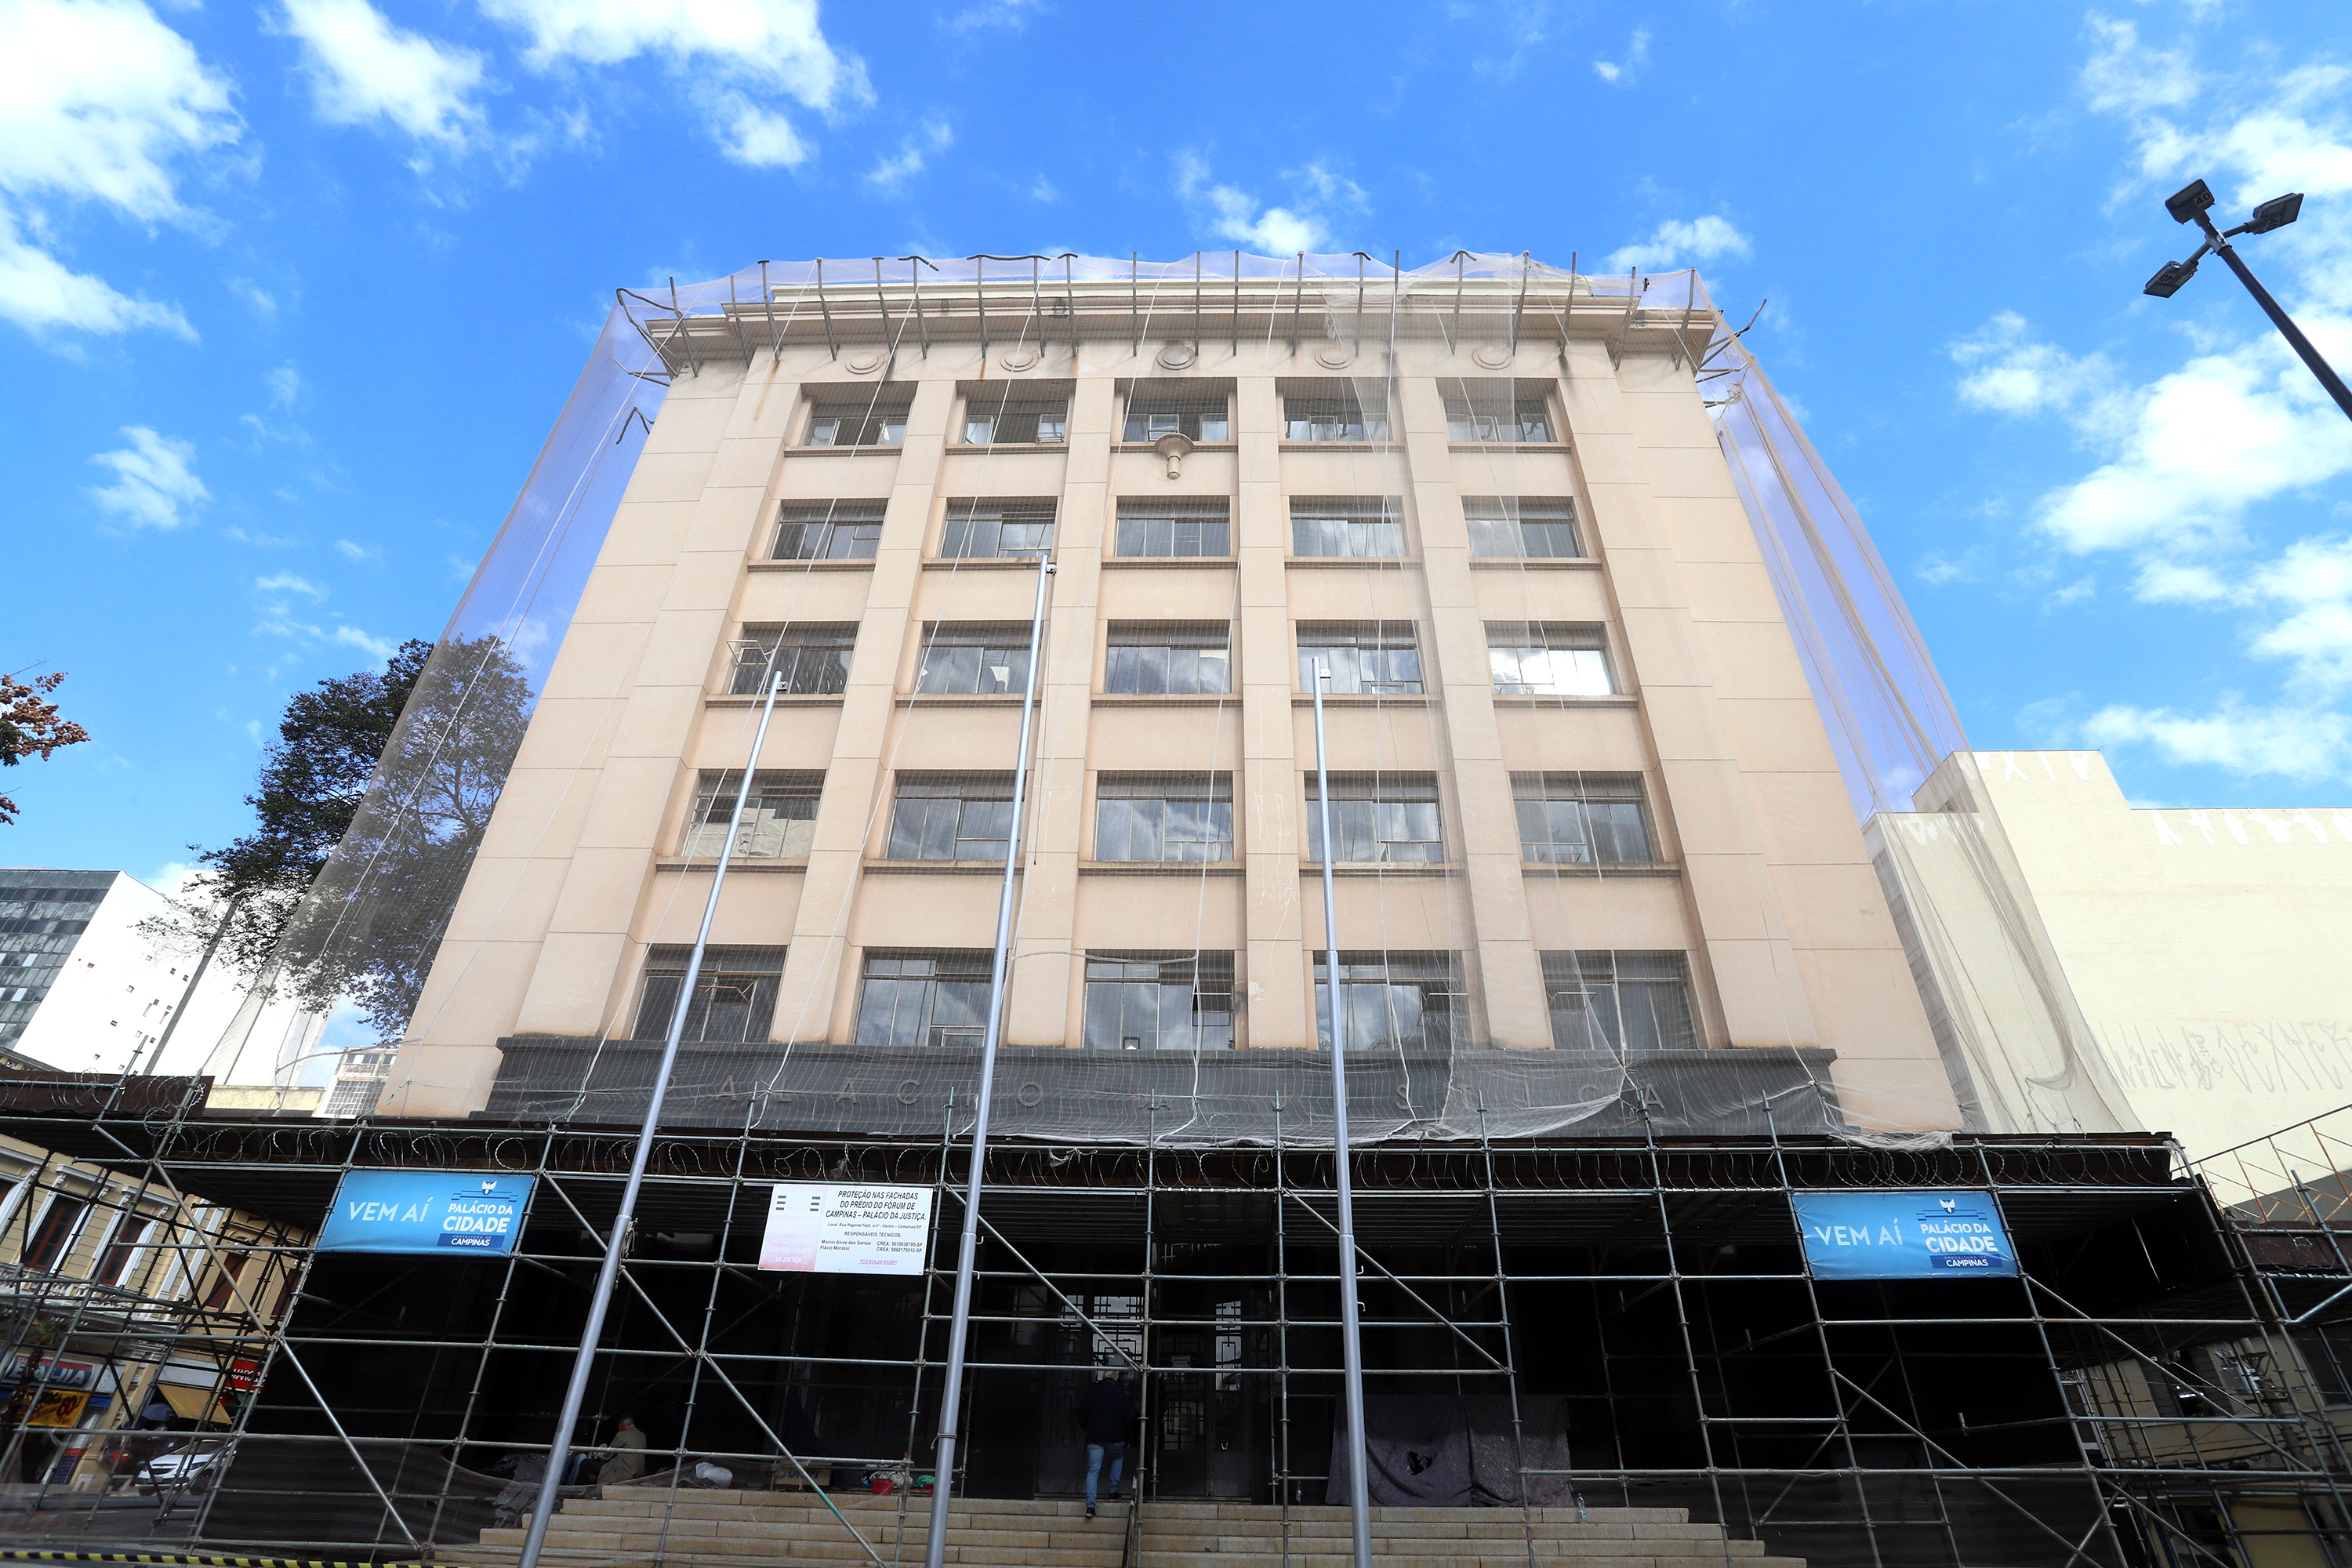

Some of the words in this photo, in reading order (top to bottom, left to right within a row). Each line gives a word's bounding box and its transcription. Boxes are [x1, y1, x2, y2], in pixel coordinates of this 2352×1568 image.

[837, 1189, 871, 1200] PROTEÇÃO
[872, 1191, 884, 1200] NAS
[885, 1192, 919, 1200] FACHADAS
[350, 1201, 400, 1221] VEM
[400, 1196, 434, 1222] AÍ
[448, 1200, 497, 1214] PALÁCIO
[497, 1204, 514, 1215] DA
[849, 1199, 873, 1209] PRÉDIO
[883, 1200, 906, 1210] FÓRUM
[826, 1210, 858, 1218] CAMPINAS
[862, 1210, 889, 1220] PALÁCIO
[443, 1215, 511, 1233] CIDADE
[1920, 1219, 1972, 1234] PALÁCIO
[1973, 1223, 1992, 1233] DA
[1813, 1225, 1871, 1246] VEM
[1878, 1218, 1904, 1246] AÍ
[451, 1237, 491, 1247] CAMPINAS
[1926, 1236, 1998, 1253] CIDADE
[1946, 1258, 1989, 1267] CAMPINAS
